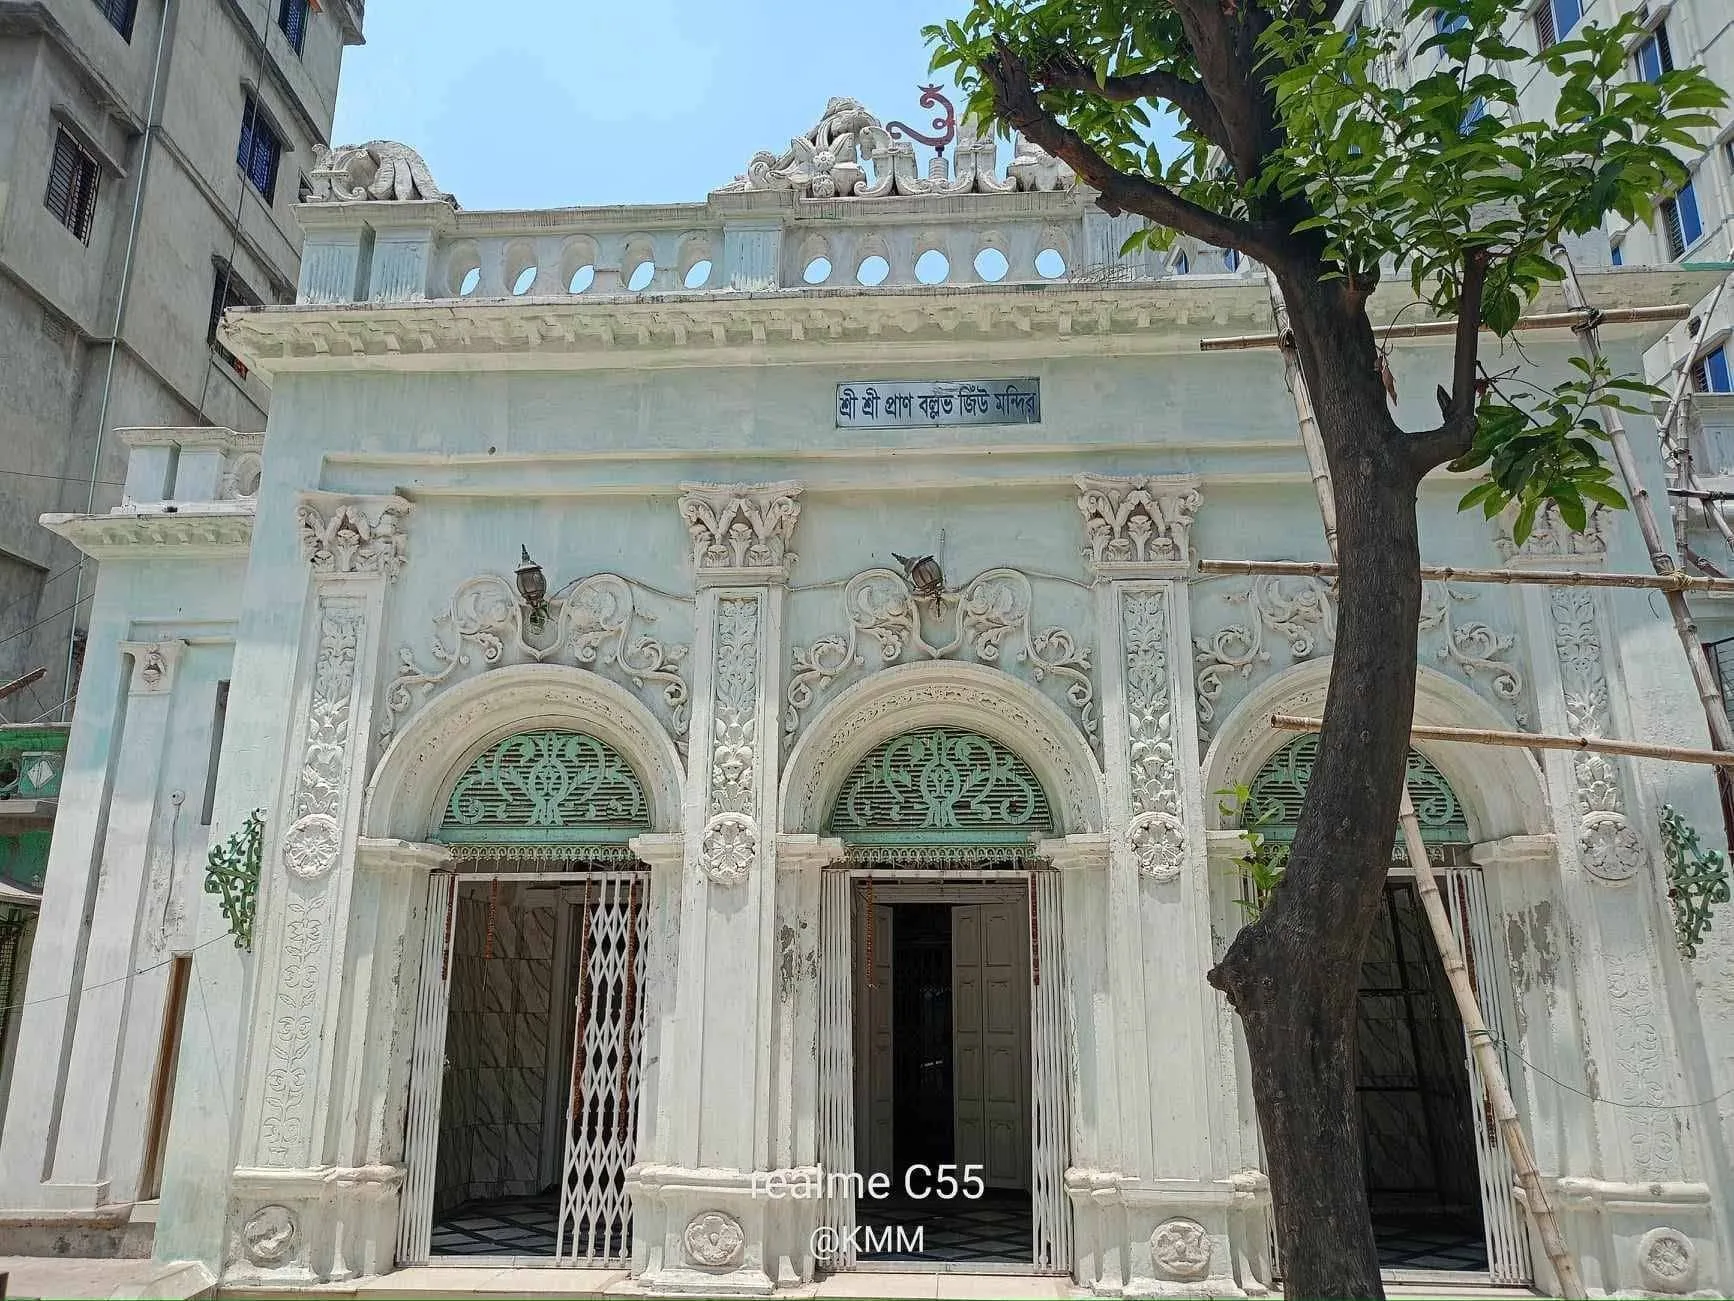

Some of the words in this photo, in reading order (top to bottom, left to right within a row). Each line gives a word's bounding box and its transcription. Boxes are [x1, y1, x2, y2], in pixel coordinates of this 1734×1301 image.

[839, 388, 858, 421] শ্রী
[862, 387, 880, 420] শ্রী
[885, 392, 914, 420] প্রাণ
[917, 394, 954, 420] বল্লভ
[992, 385, 1037, 417] মন্দির
